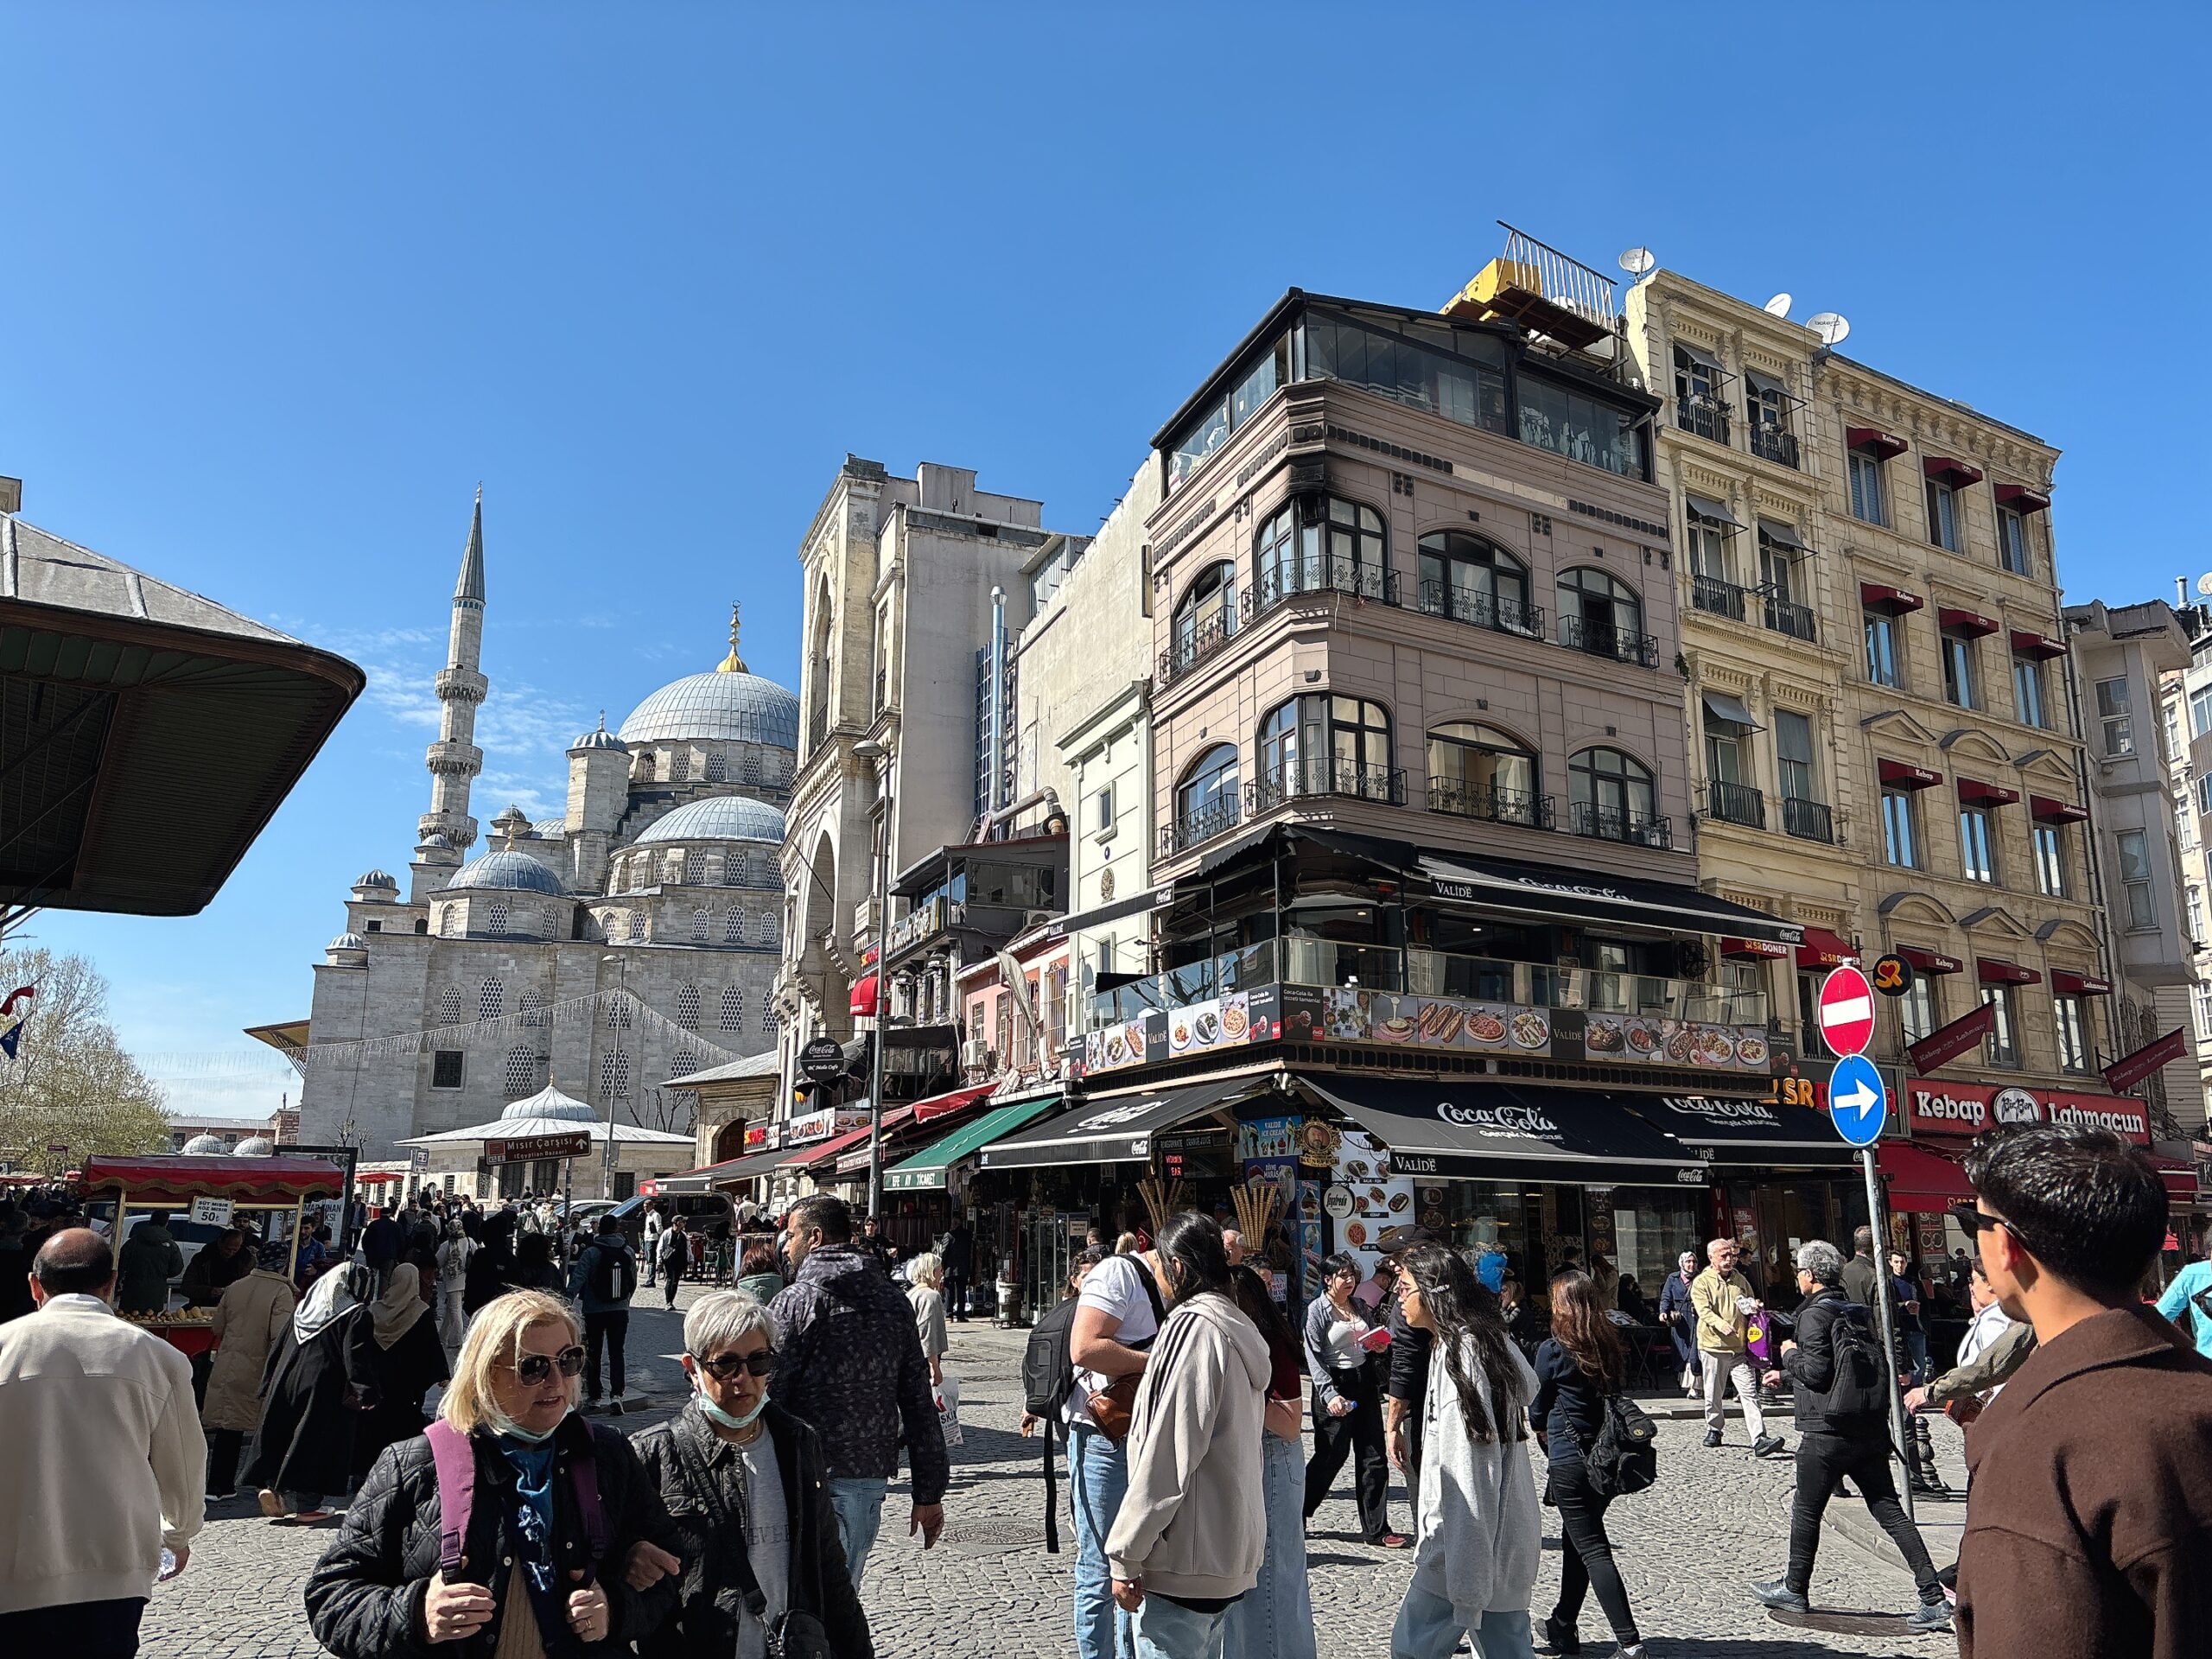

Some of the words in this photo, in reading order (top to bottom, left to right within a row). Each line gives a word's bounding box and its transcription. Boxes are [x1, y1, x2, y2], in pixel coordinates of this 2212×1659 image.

[1935, 957, 1955, 969] Kebap
[1916, 1090, 1985, 1126] Kebap
[2048, 1103, 2145, 1133] Lahmacun
[507, 1141, 533, 1151] Mısır
[537, 1138, 572, 1149] Çarşısı
[514, 1151, 543, 1160] (Egyptian
